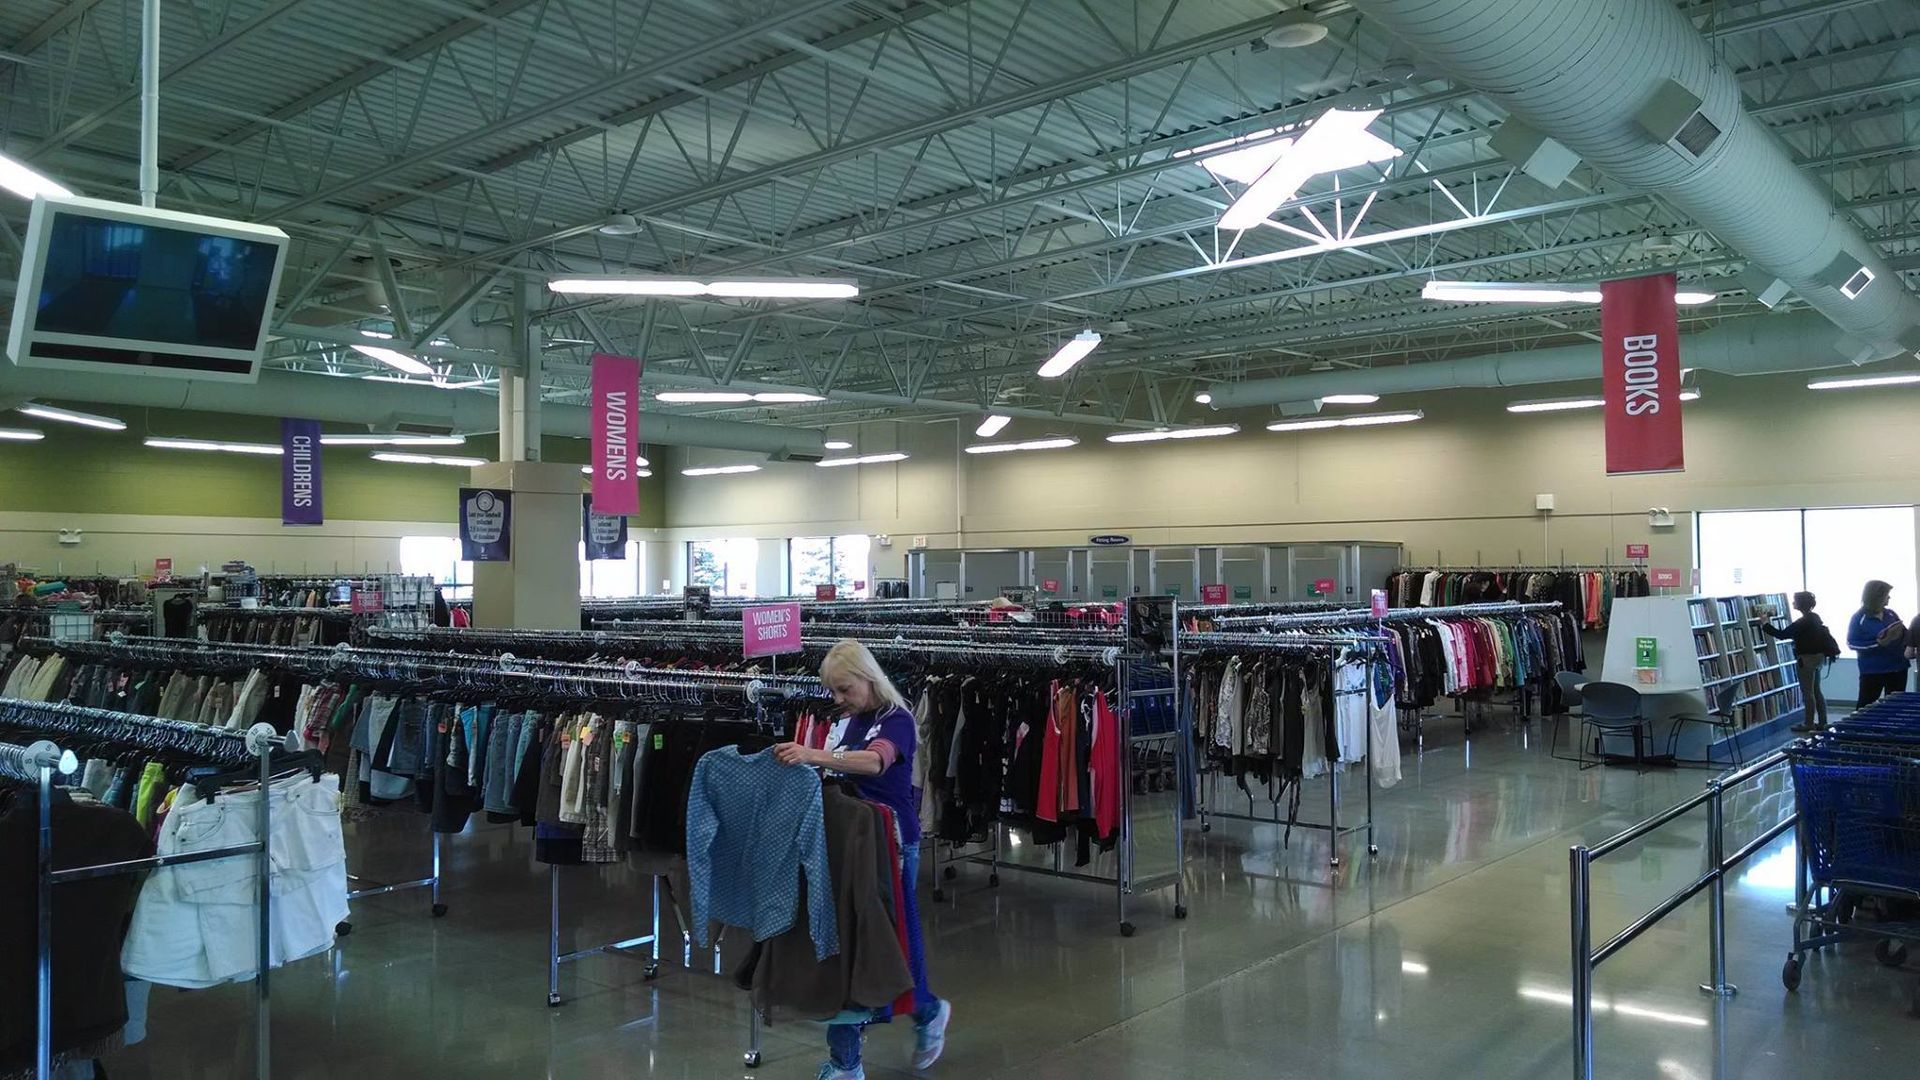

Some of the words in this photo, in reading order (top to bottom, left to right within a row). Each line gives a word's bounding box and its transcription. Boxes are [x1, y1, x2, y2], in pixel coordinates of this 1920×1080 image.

[1623, 334, 1660, 416] BOOKS
[292, 435, 312, 507] CHILDRENS
[606, 391, 627, 481] WOMENS
[752, 608, 791, 626] WOMEN'S
[757, 624, 788, 640] SHORTS
